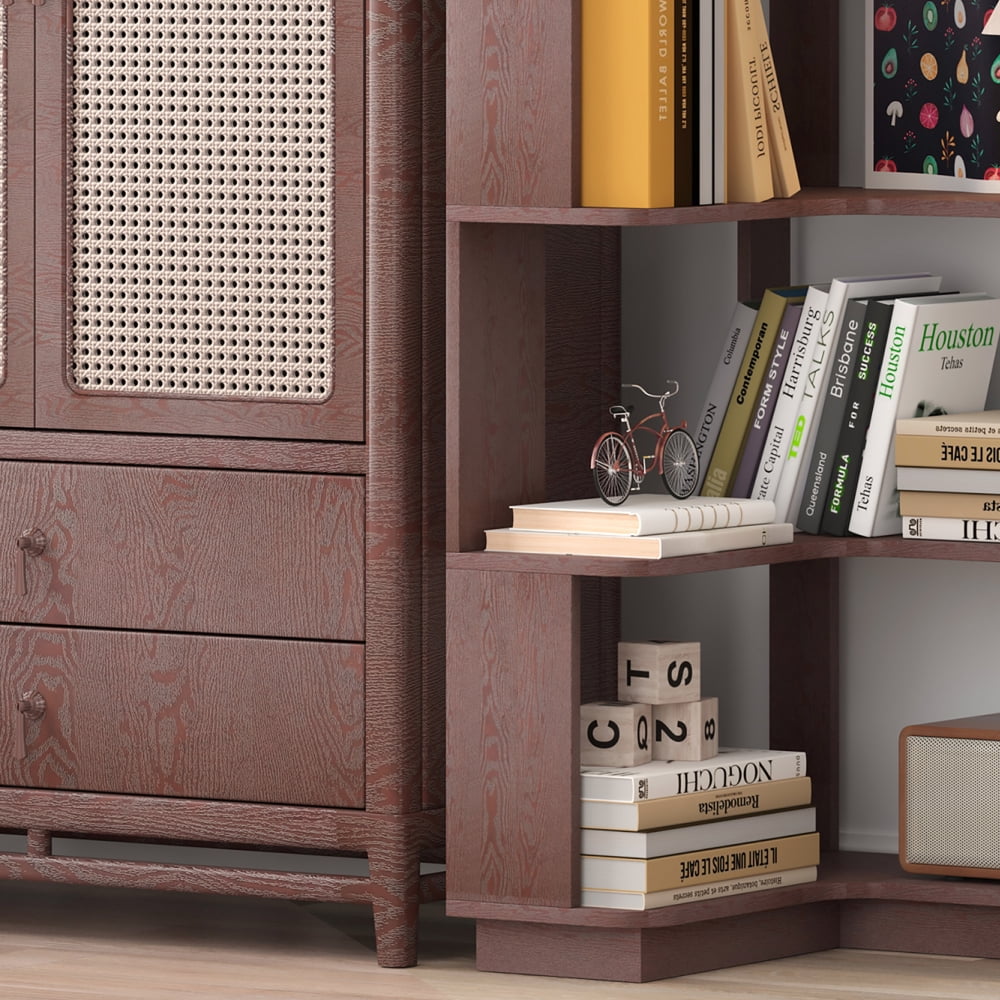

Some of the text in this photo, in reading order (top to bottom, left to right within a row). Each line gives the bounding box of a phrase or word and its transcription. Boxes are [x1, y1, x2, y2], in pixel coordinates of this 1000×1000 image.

[723, 327, 741, 366] Columbia
[782, 306, 821, 399] Harrisburg
[858, 321, 878, 381] SUCCESS
[917, 321, 996, 352] Houston
[736, 322, 768, 406] Contemporan
[830, 319, 859, 398] Brisbane
[878, 325, 907, 400] Houston
[940, 356, 964, 371] Tehas
[753, 328, 790, 430] FORM STYLE
[787, 309, 834, 461] TED TALKS
[848, 401, 860, 429] FOR
[763, 425, 785, 474] Capital
[805, 451, 828, 517] Queensland
[829, 453, 851, 514] FORMULA
[856, 475, 874, 513] Tehas
[676, 759, 774, 795] NOGUCHI
[698, 794, 760, 816] Remodelista
[680, 859, 700, 883] CAFÉ
[701, 857, 711, 876] LE
[712, 855, 730, 874] FOIS
[731, 852, 747, 871] UNE
